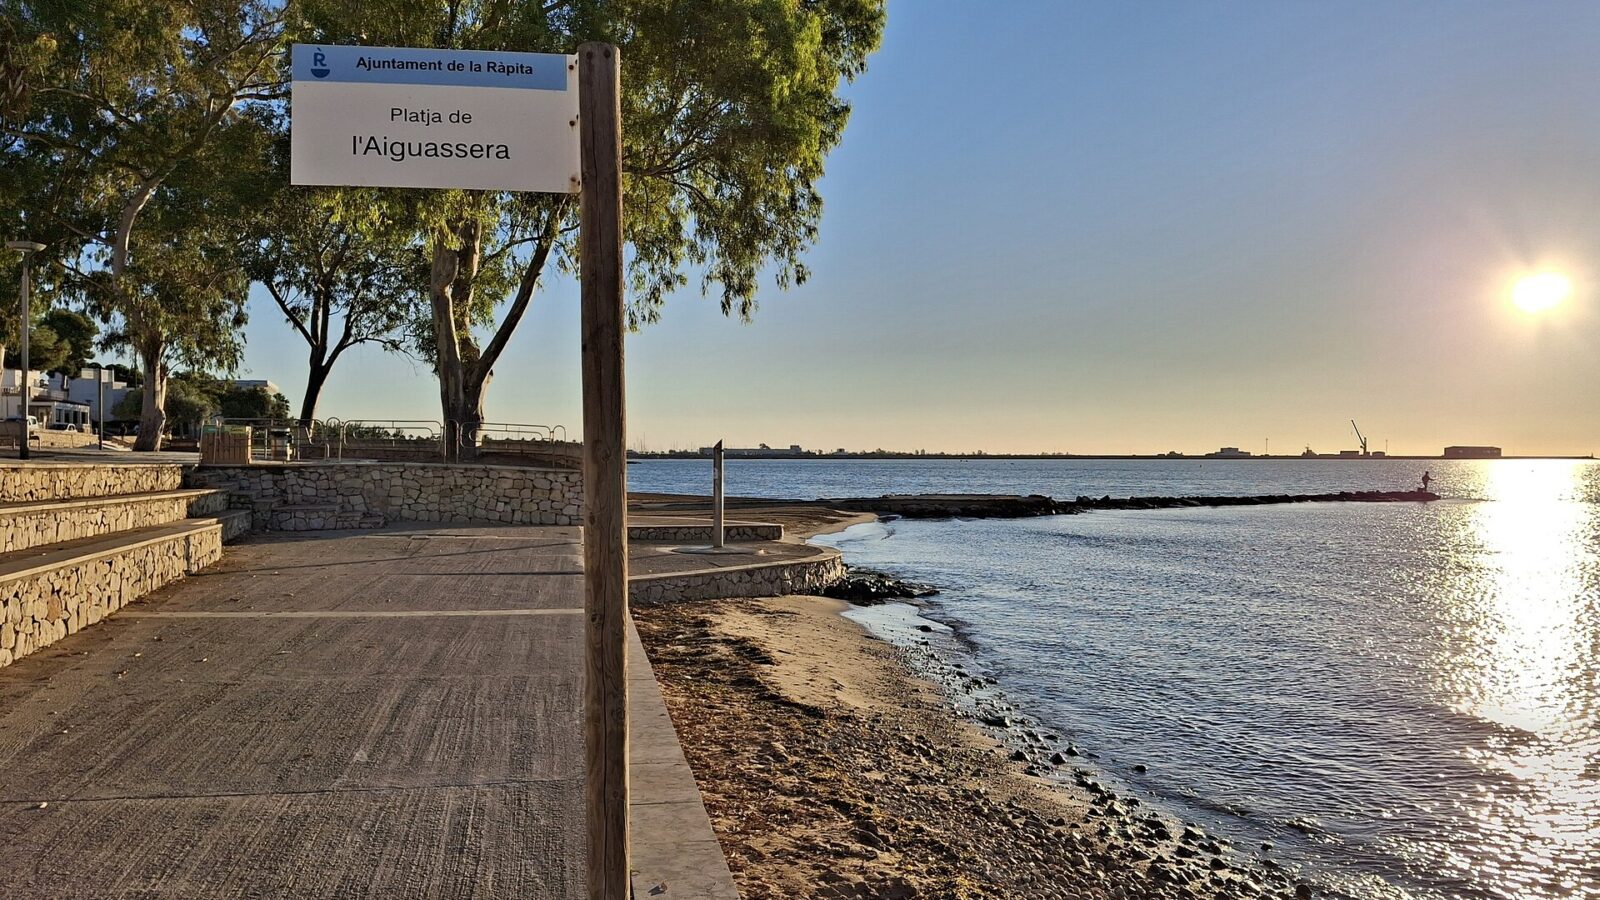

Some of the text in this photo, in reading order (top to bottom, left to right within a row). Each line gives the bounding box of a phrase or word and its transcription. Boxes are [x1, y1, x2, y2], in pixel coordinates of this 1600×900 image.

[356, 56, 533, 77] Ajuntament de la Ràpita
[390, 108, 472, 126] Platja de
[352, 135, 510, 162] l'Aiguassera
